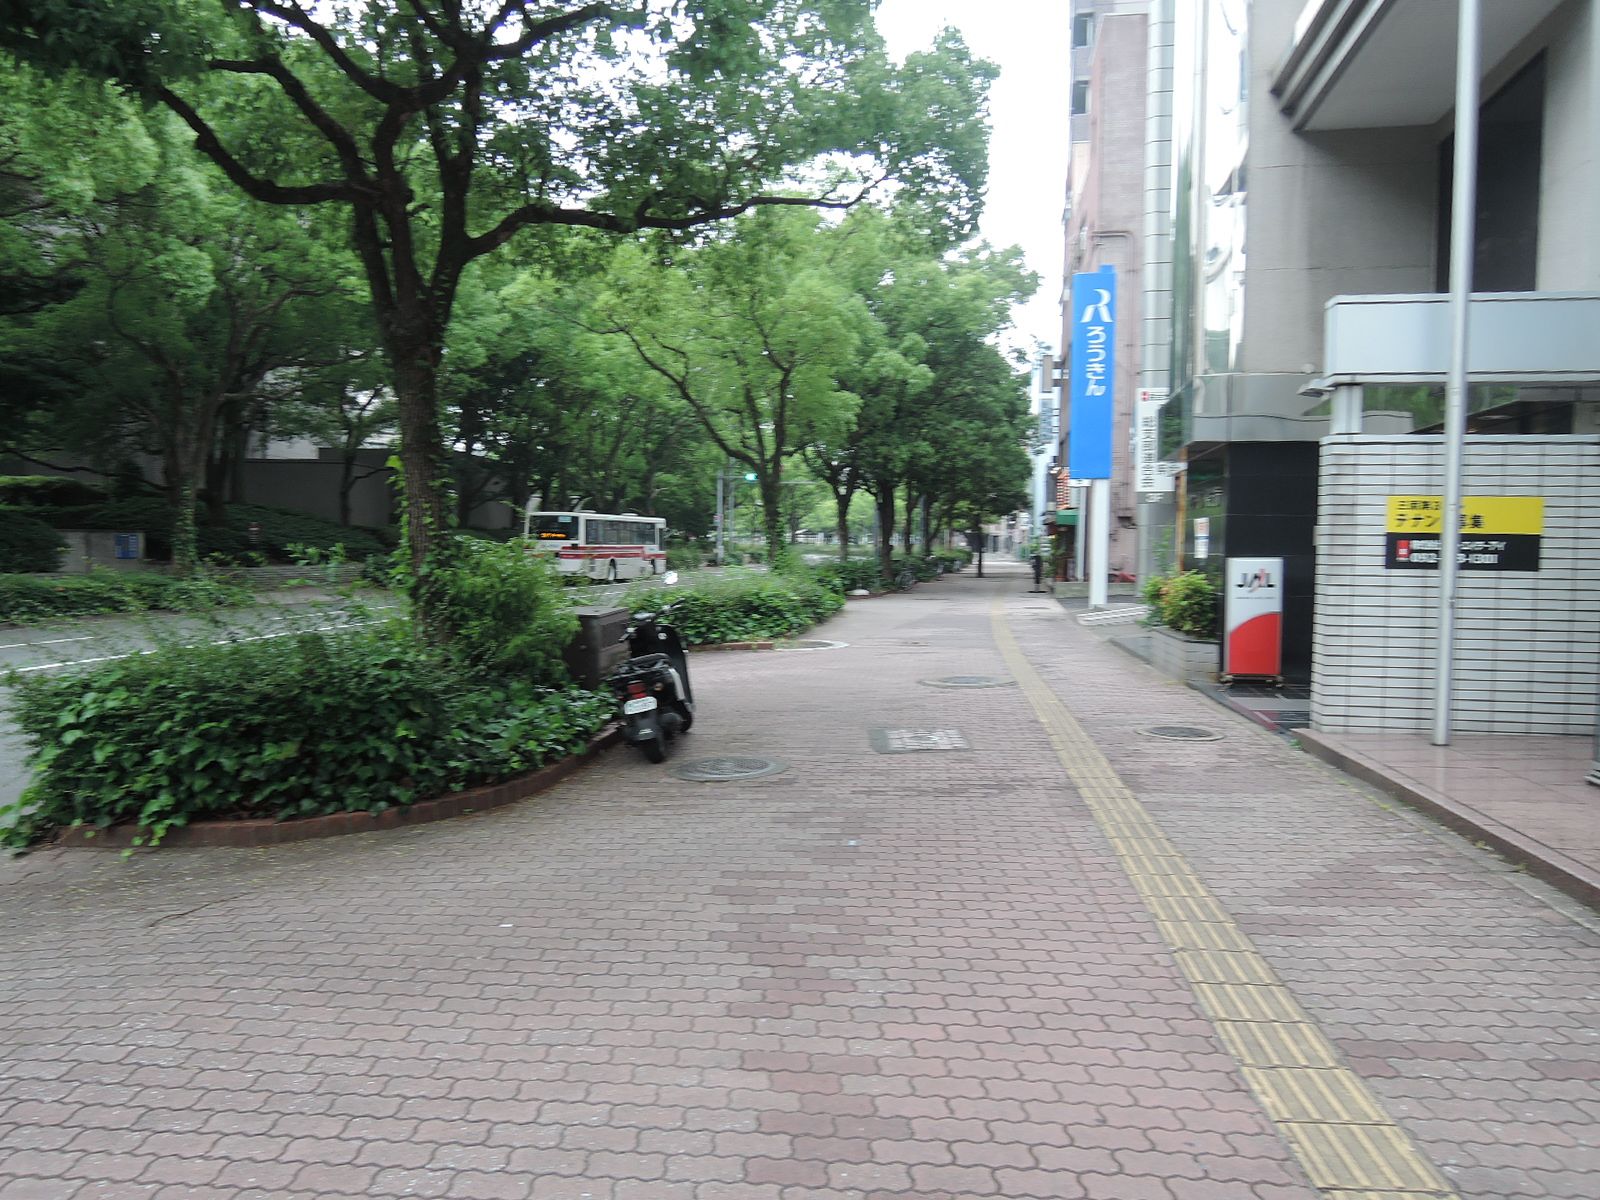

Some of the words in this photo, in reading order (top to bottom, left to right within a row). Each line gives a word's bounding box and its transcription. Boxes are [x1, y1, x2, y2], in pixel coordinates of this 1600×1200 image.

[1085, 326, 1107, 396] ろうきん
[1396, 514, 1484, 529] テナン募集
